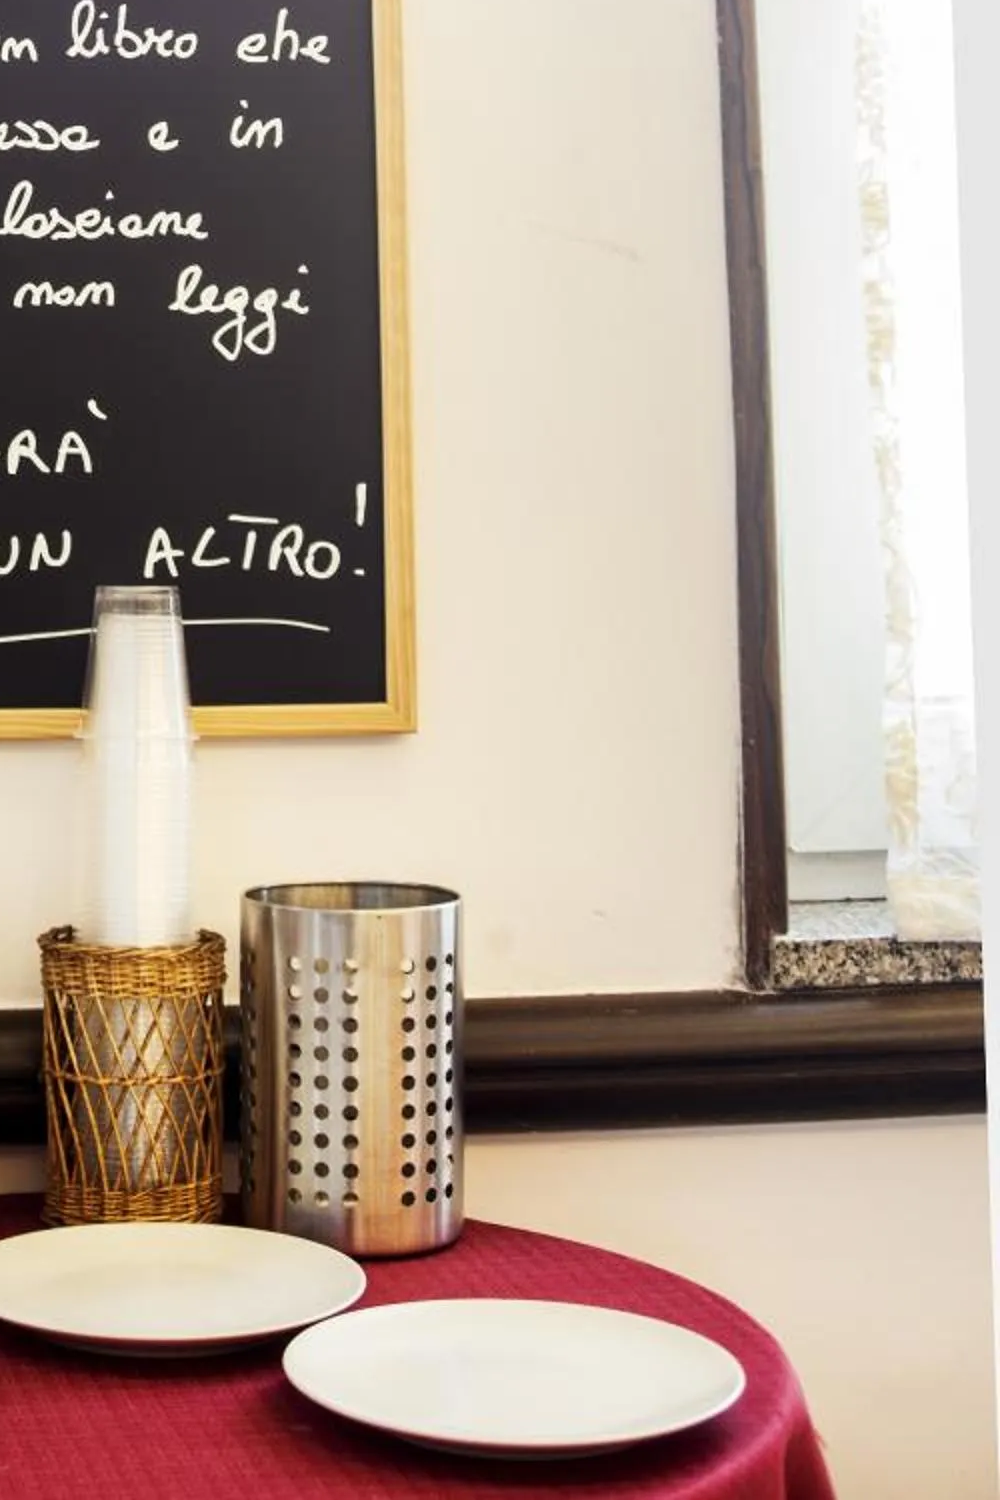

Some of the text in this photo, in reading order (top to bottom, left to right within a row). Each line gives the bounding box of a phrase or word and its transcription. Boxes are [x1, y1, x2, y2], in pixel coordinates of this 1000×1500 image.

[236, 7, 331, 64] che
[148, 122, 179, 153] e
[229, 100, 284, 149] in
[13, 279, 116, 308] non
[169, 264, 310, 360] leggi
